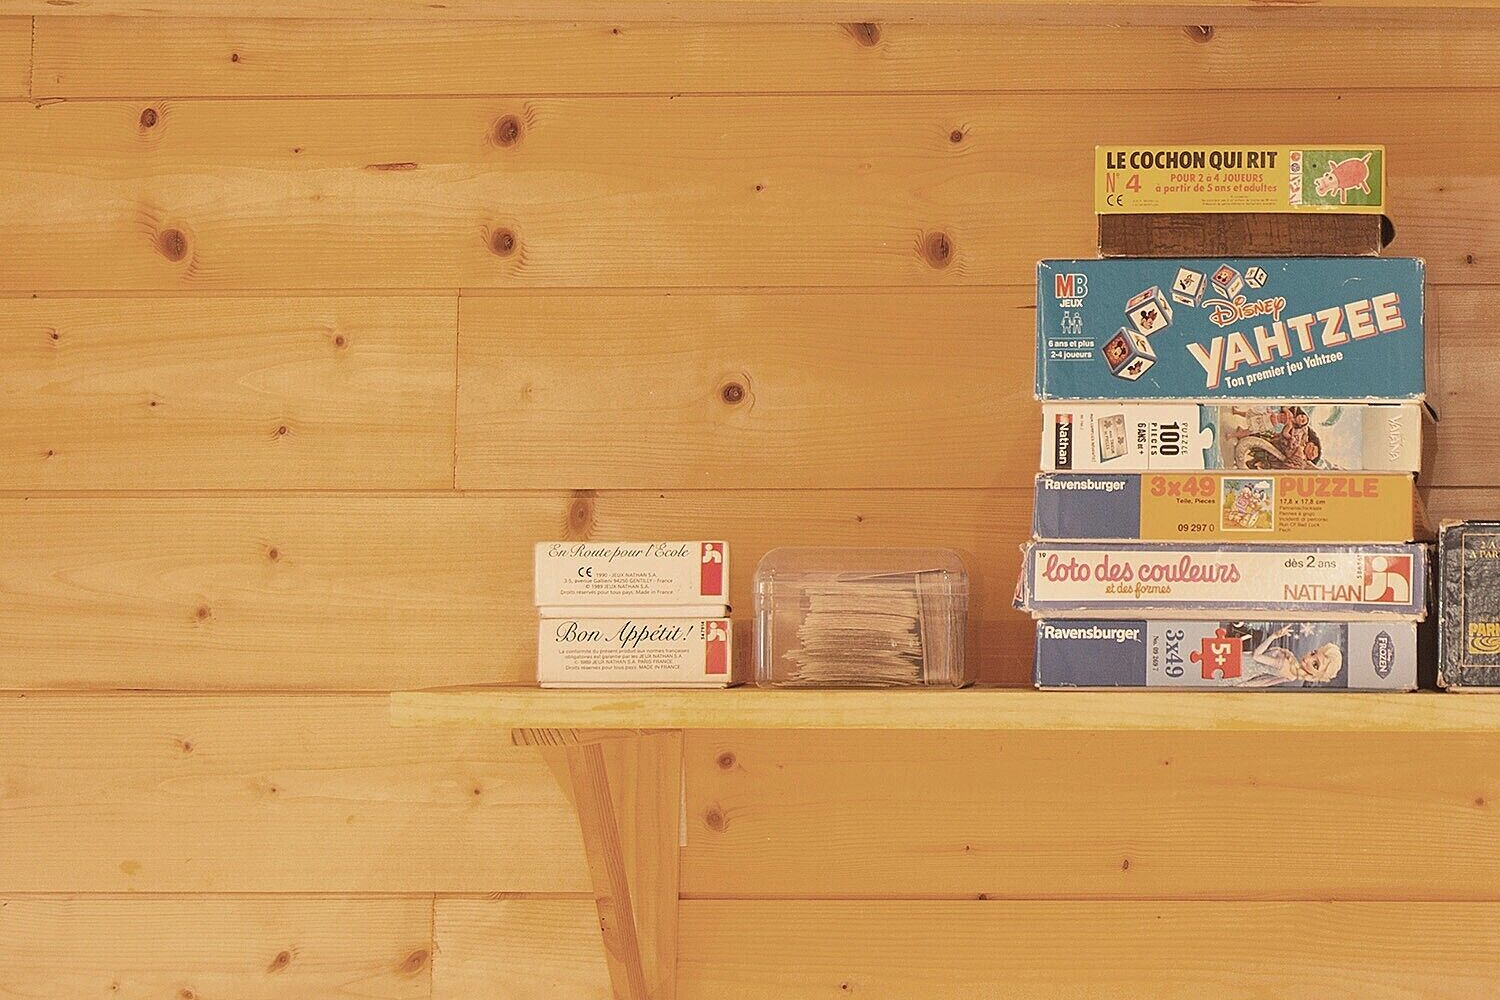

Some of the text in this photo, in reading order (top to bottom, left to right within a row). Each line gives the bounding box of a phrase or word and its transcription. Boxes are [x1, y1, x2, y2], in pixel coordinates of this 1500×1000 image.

[1107, 151, 1278, 170] LE COCHON QUI RIT
[1126, 174, 1142, 193] 4
[1170, 174, 1197, 182] POUR
[1199, 174, 1204, 182] 2
[1214, 174, 1220, 182] 4
[1222, 174, 1264, 182] JOUEURS
[1165, 184, 1192, 195] partir
[1194, 184, 1205, 192] de
[1207, 184, 1212, 192] 5
[1233, 184, 1242, 192] et
[1242, 183, 1277, 192] adultes
[1055, 273, 1088, 299] MB
[1060, 299, 1083, 308] JEUX
[1186, 292, 1406, 389] YAHTZEE
[1225, 351, 1343, 388] Ton premier jeu Yahtzee
[1059, 422, 1070, 465] Nathan
[1160, 422, 1180, 455] 100
[1045, 479, 1125, 491] Ravensburger
[1151, 476, 1215, 497] 3x49
[1279, 478, 1378, 497] PUZZLE
[548, 544, 567, 557] En
[570, 544, 612, 558] Route
[609, 548, 644, 562] pour
[1042, 554, 1241, 583] loto des couleurs
[1284, 584, 1362, 601] NATHAN
[555, 621, 601, 642] Bon
[1045, 626, 1140, 642] Ravensburger
[1165, 629, 1184, 678] 3x49
[1377, 637, 1388, 673] FROZEN
